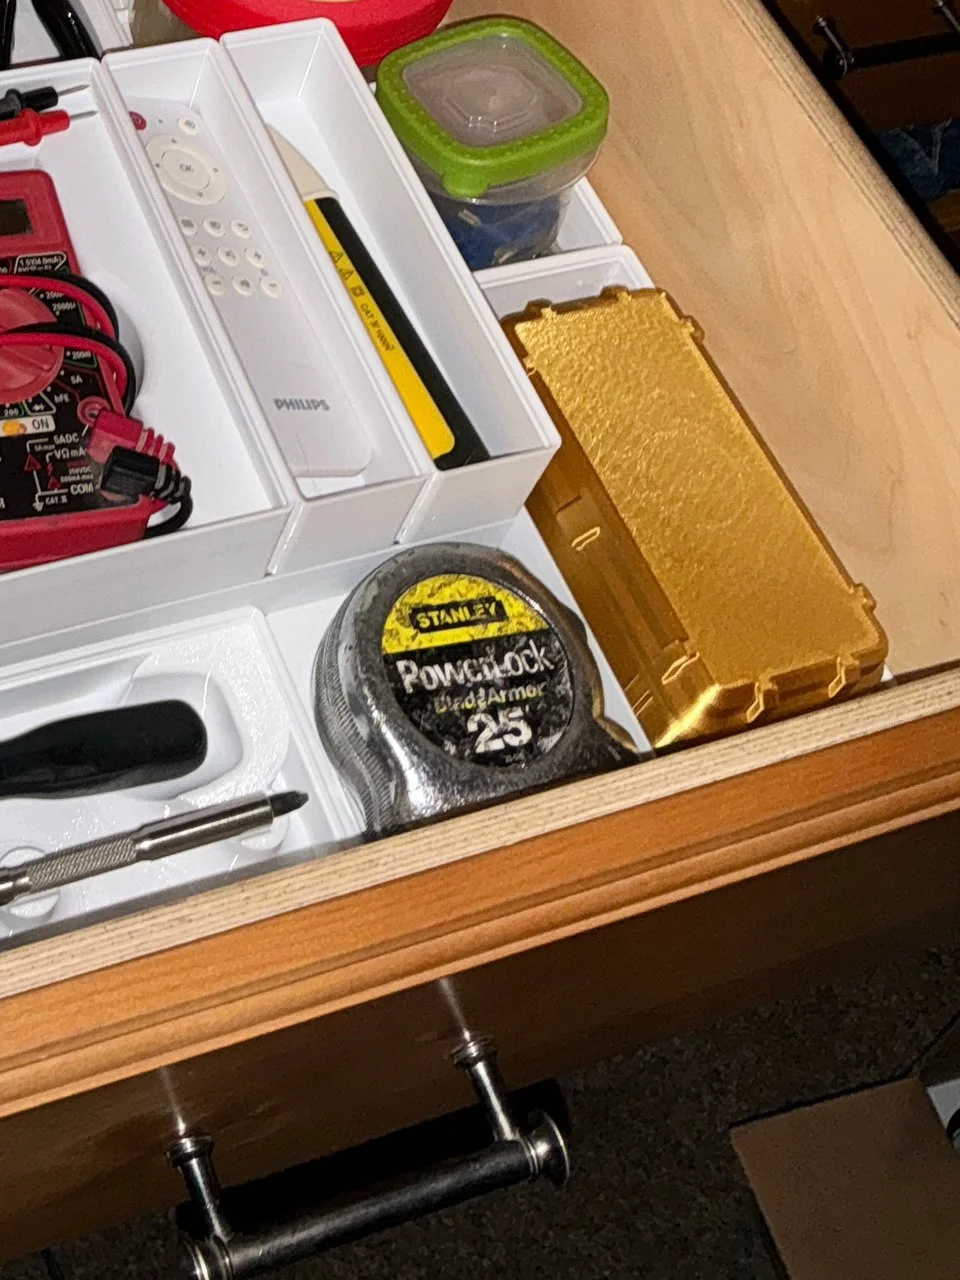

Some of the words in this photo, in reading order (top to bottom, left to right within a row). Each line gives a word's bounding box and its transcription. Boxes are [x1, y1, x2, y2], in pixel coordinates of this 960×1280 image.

[273, 398, 330, 412] PHILIPS
[32, 418, 50, 431] ON
[70, 481, 94, 495] COM
[416, 602, 498, 629] STANLEY
